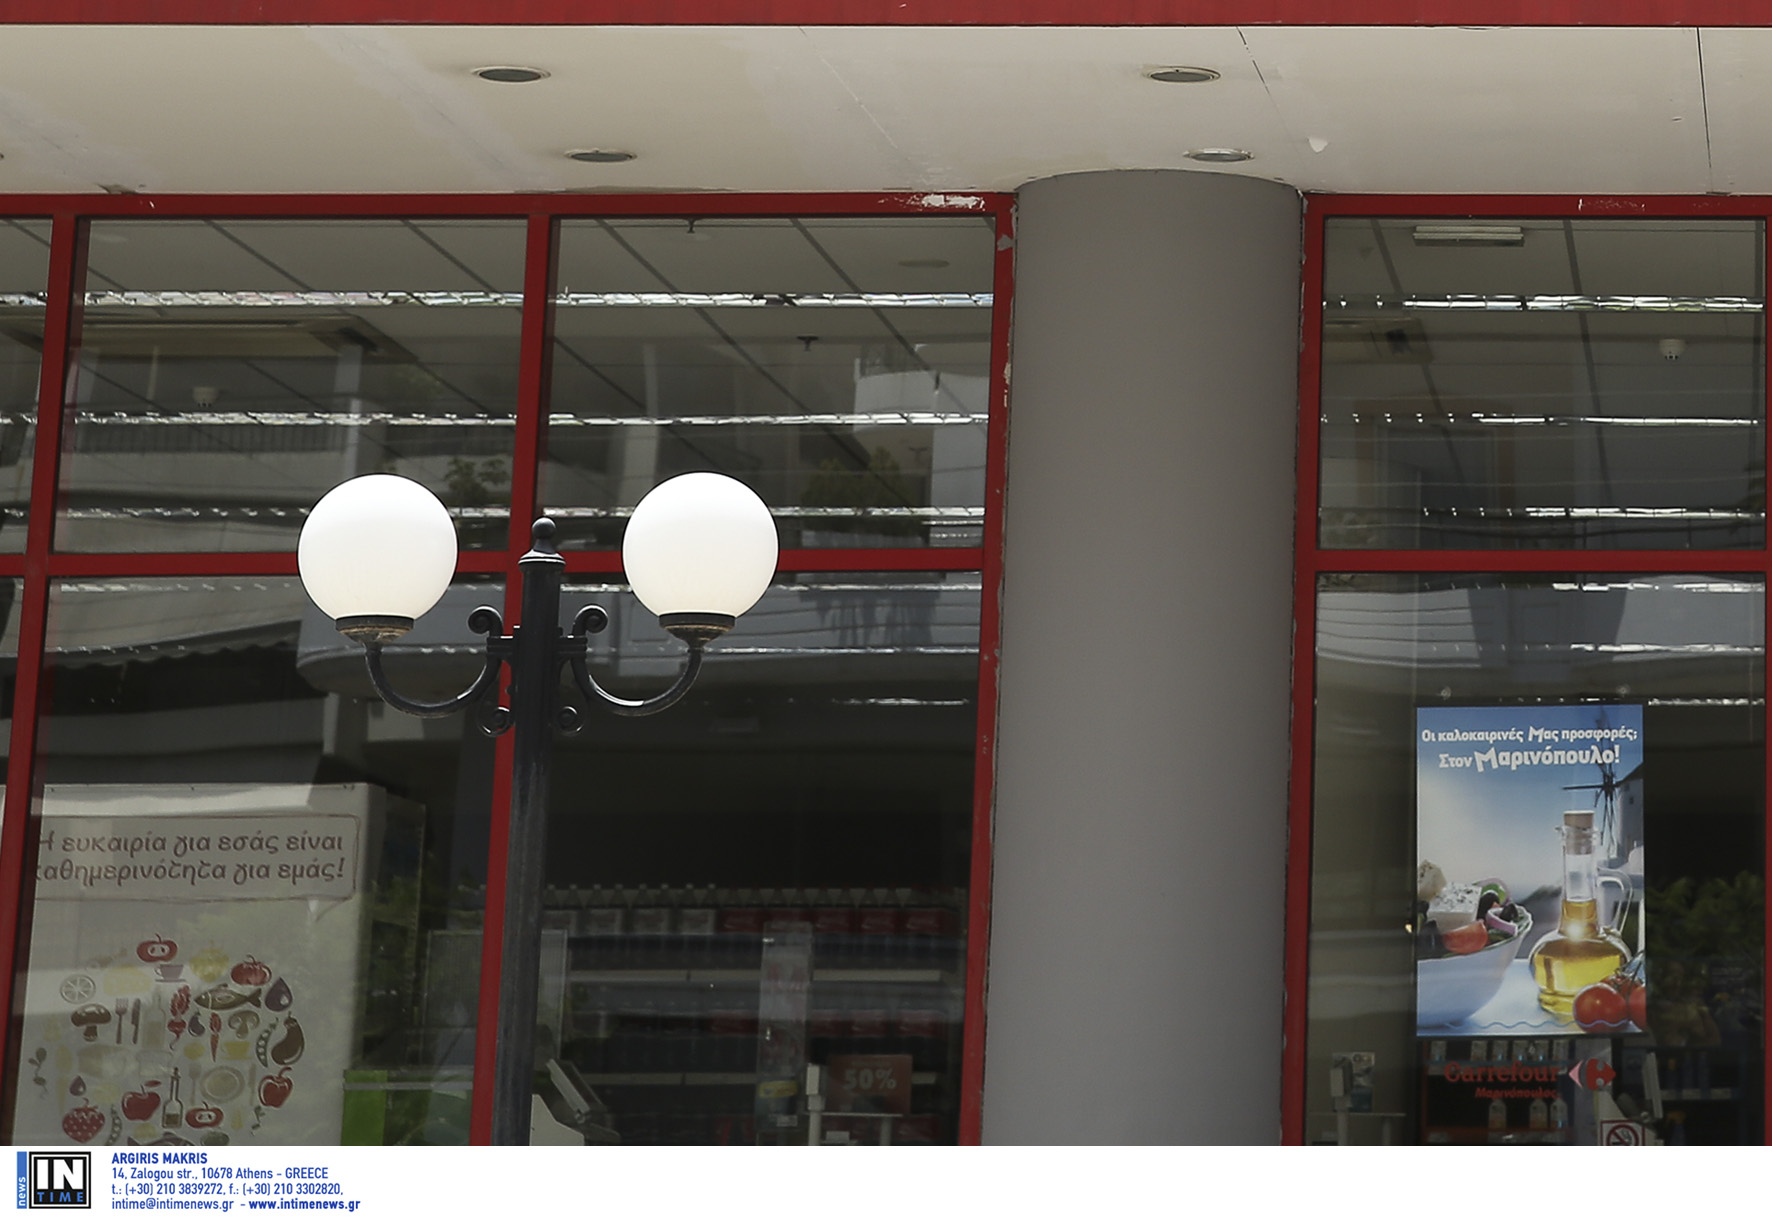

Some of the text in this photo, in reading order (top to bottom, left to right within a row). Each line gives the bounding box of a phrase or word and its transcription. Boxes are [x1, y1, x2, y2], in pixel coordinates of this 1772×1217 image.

[1421, 729, 1437, 742] Οι
[1438, 727, 1524, 743] καλοκαιρινές
[1438, 744, 1621, 772] Στον Μαρινόπουλο!
[62, 831, 167, 858] ευκαιρία
[173, 834, 211, 857] για
[217, 830, 279, 855] εσάς
[286, 831, 343, 853] είναι
[233, 861, 271, 885] για
[277, 857, 345, 886] εμάς!
[1443, 1060, 1560, 1083] Carrefour
